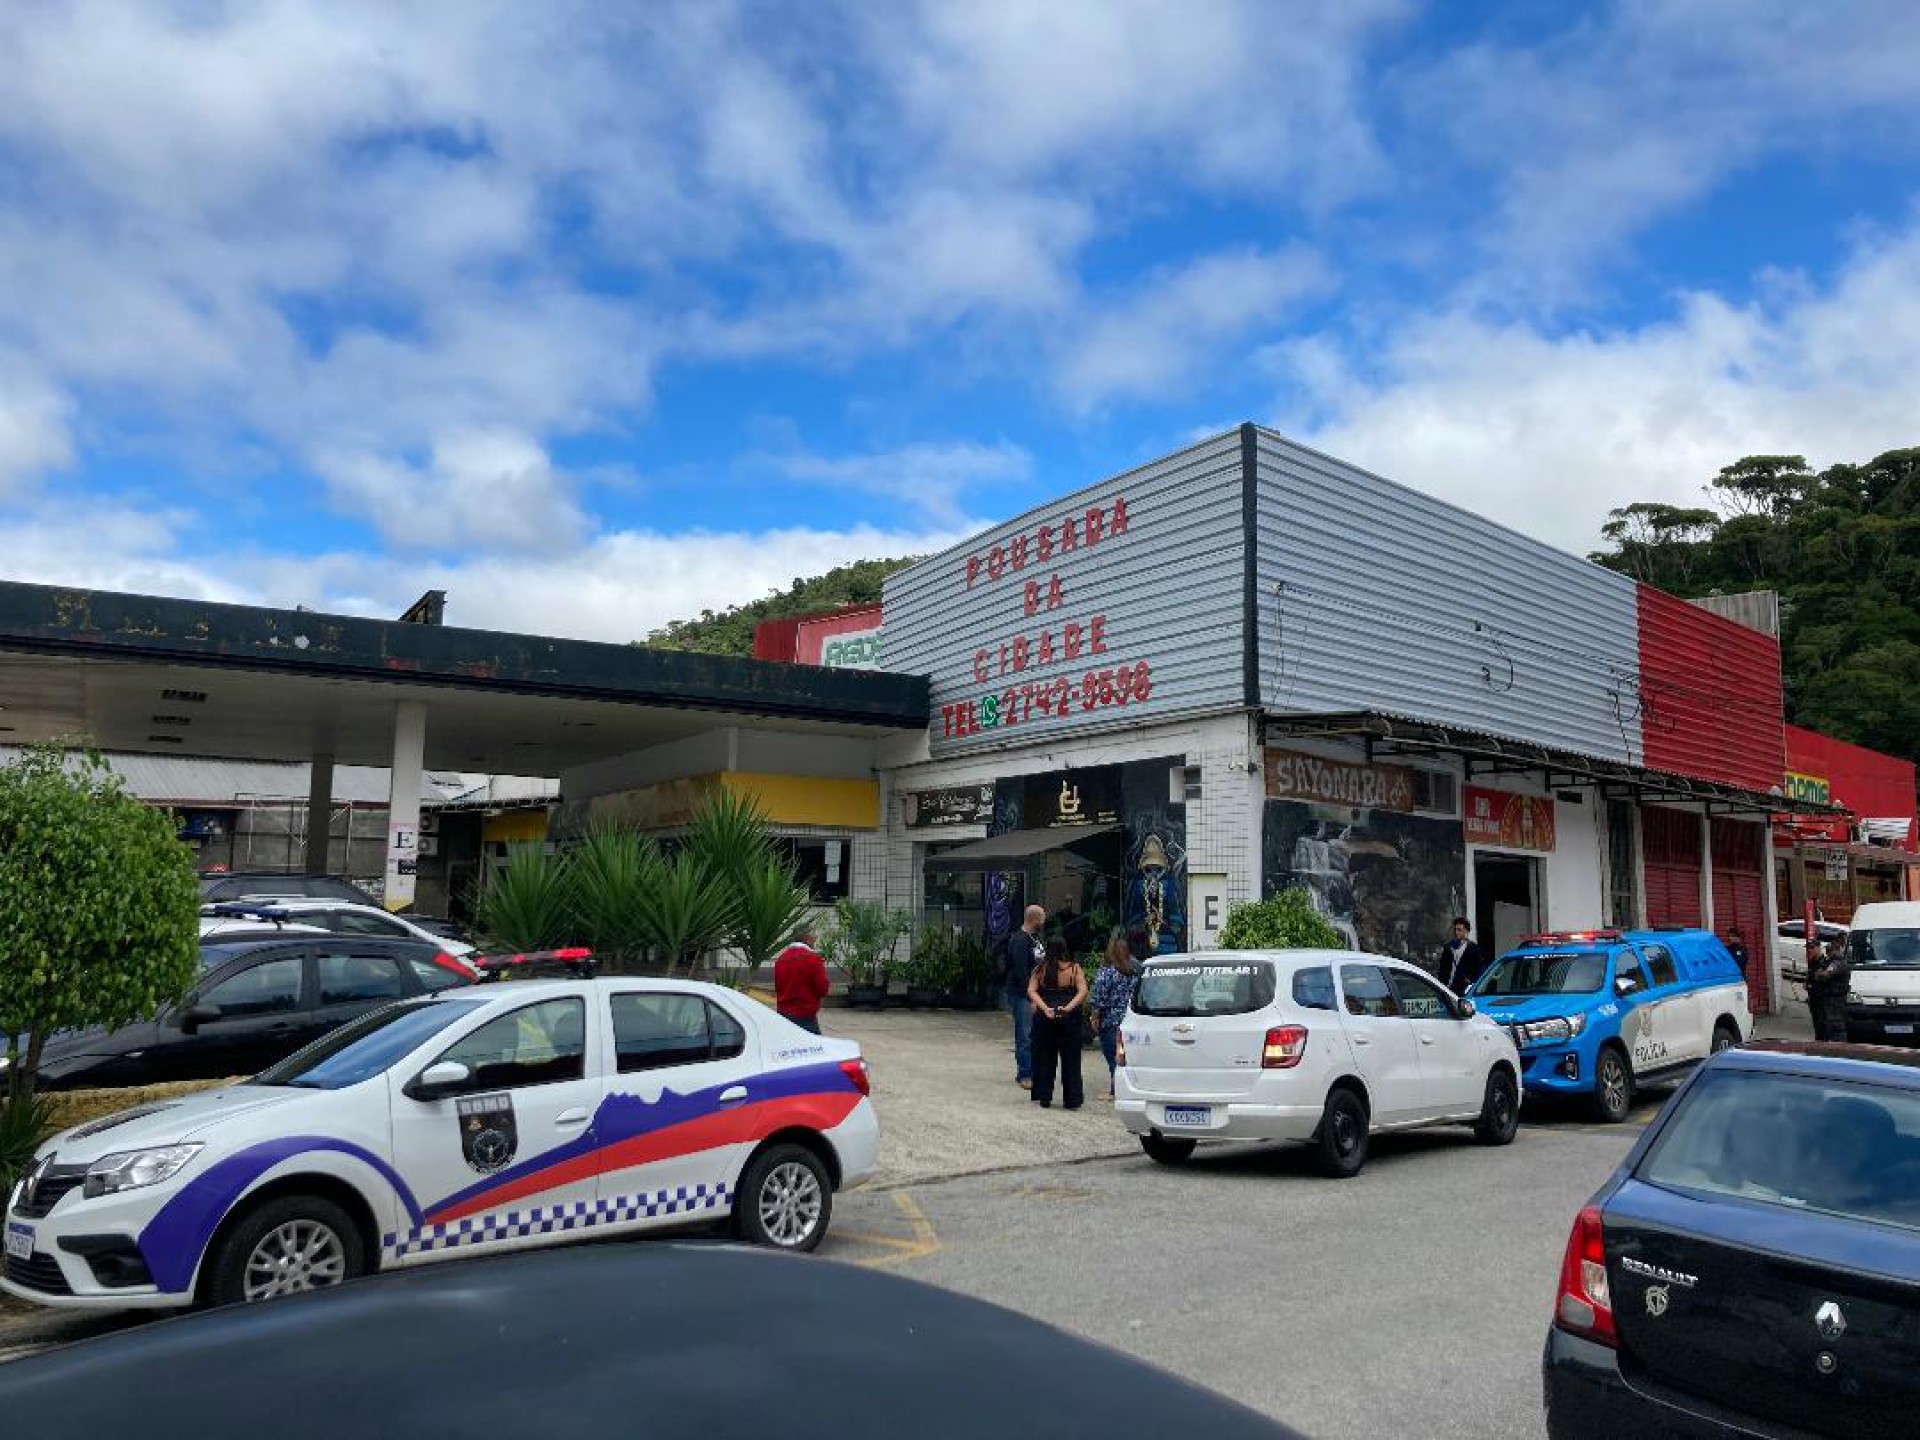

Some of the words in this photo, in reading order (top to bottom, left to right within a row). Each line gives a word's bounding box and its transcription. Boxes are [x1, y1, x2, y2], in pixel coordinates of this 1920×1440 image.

[966, 497, 1129, 592] POUSADA
[1023, 573, 1064, 617] DA
[973, 614, 1108, 684] CIDADE
[941, 702, 981, 740] TEL
[1277, 756, 1386, 806] SAYONARA
[393, 831, 414, 849] E
[1204, 895, 1219, 931] E
[1622, 1256, 1698, 1287] RENAULT
